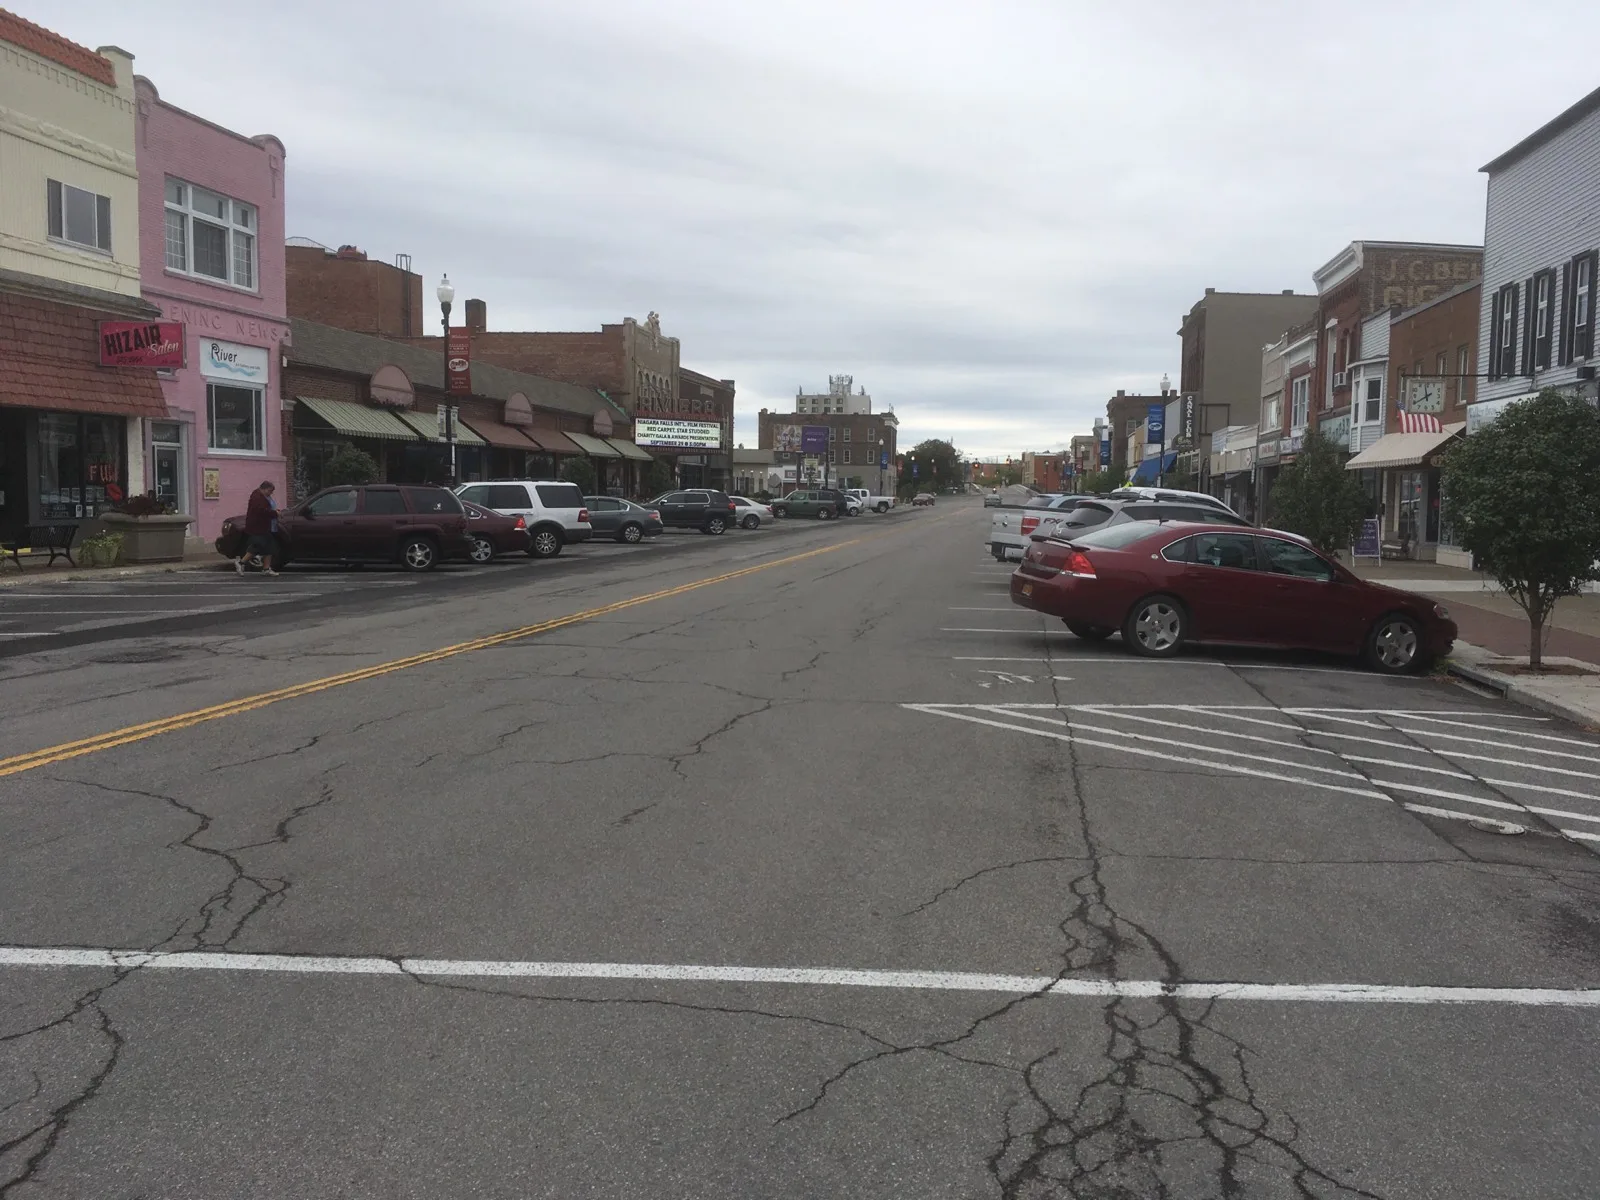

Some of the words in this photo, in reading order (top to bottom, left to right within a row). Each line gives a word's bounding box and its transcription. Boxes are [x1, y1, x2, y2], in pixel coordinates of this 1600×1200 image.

[103, 324, 163, 357] HIZAIR
[235, 319, 278, 342] NEWS
[147, 340, 180, 358] Salon
[211, 343, 237, 363] River
[1185, 419, 1193, 438] CLUB
